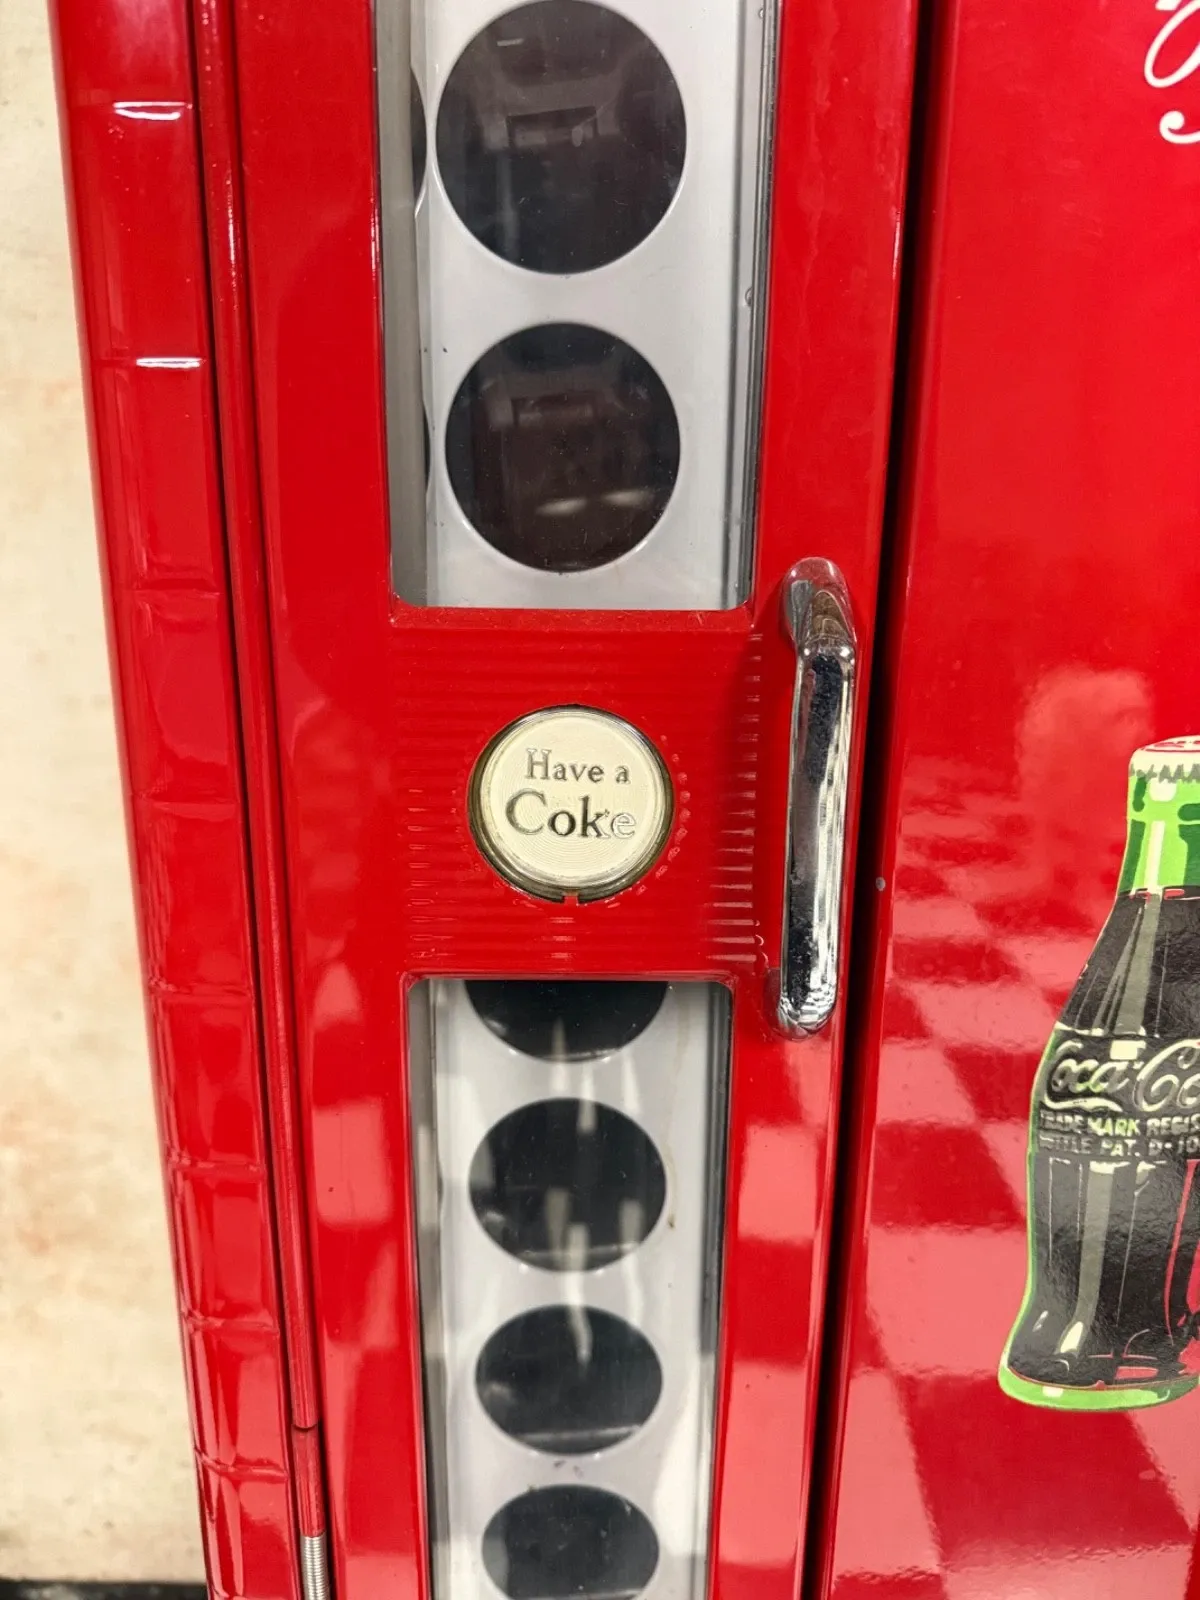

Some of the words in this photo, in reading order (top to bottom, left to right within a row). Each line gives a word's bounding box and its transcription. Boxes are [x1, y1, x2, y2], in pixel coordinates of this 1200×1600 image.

[525, 748, 604, 783] Have
[615, 764, 631, 784] a
[505, 788, 636, 839] Coke
[1087, 1117, 1141, 1137] MARK
